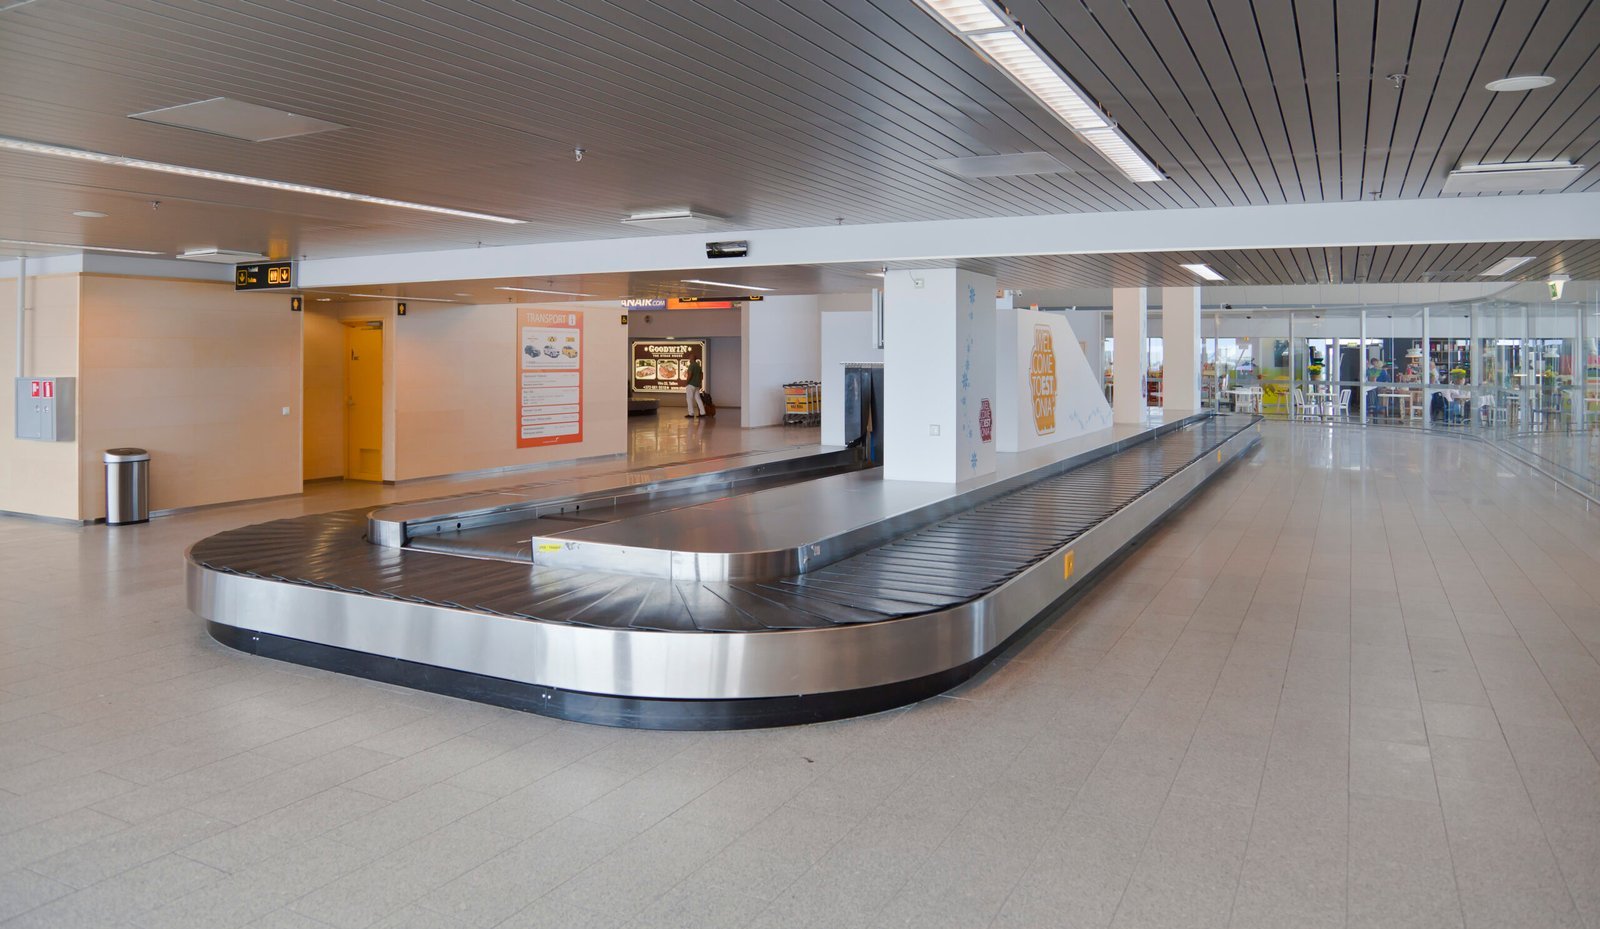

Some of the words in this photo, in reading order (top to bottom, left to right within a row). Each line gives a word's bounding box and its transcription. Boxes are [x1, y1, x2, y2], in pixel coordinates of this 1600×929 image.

[526, 313, 567, 324] TRANSPORT
[648, 345, 688, 353] GOODWIN
[1033, 353, 1053, 373] COME
